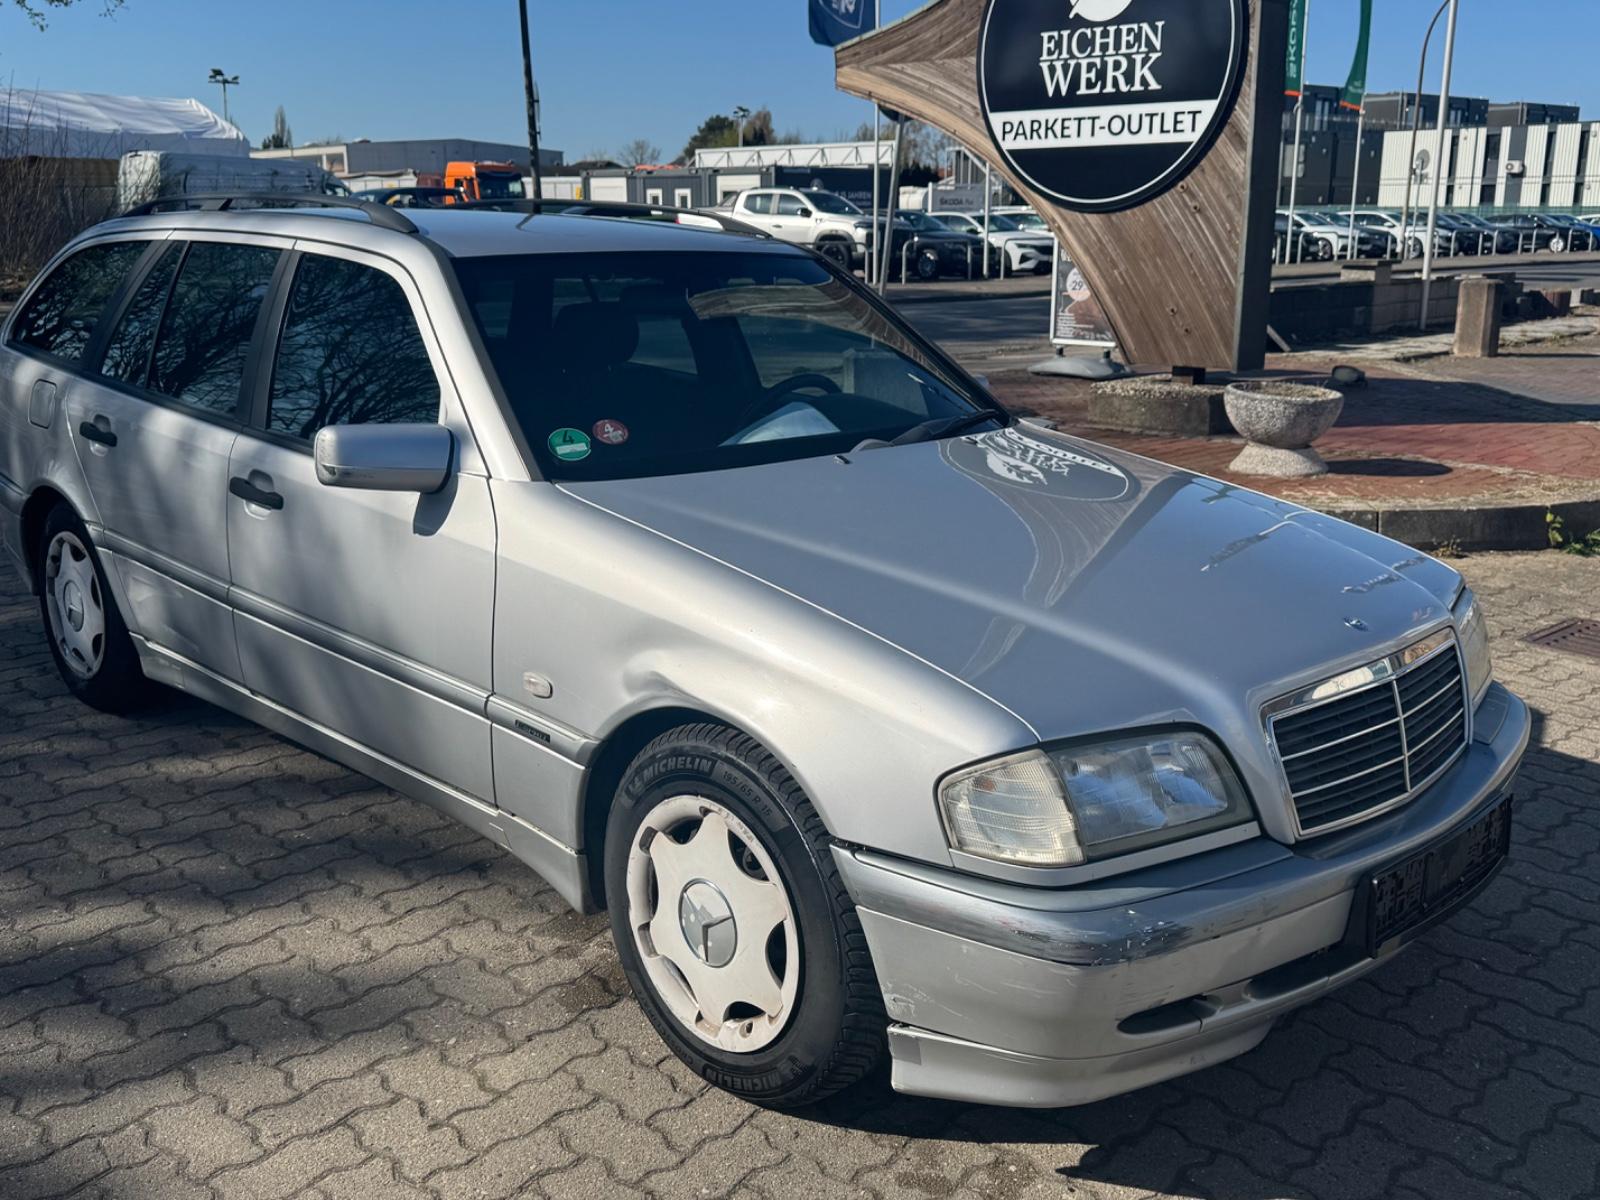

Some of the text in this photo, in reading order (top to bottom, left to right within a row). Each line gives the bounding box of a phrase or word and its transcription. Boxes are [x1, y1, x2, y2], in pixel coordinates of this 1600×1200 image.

[1039, 20, 1165, 61] EICHEN
[1039, 52, 1162, 98] WERK
[1001, 110, 1202, 142] PARKETT-OUTLET
[642, 756, 712, 781] MICHELIN
[723, 770, 753, 797] 195/65
[705, 1066, 783, 1092] MICHELIN
